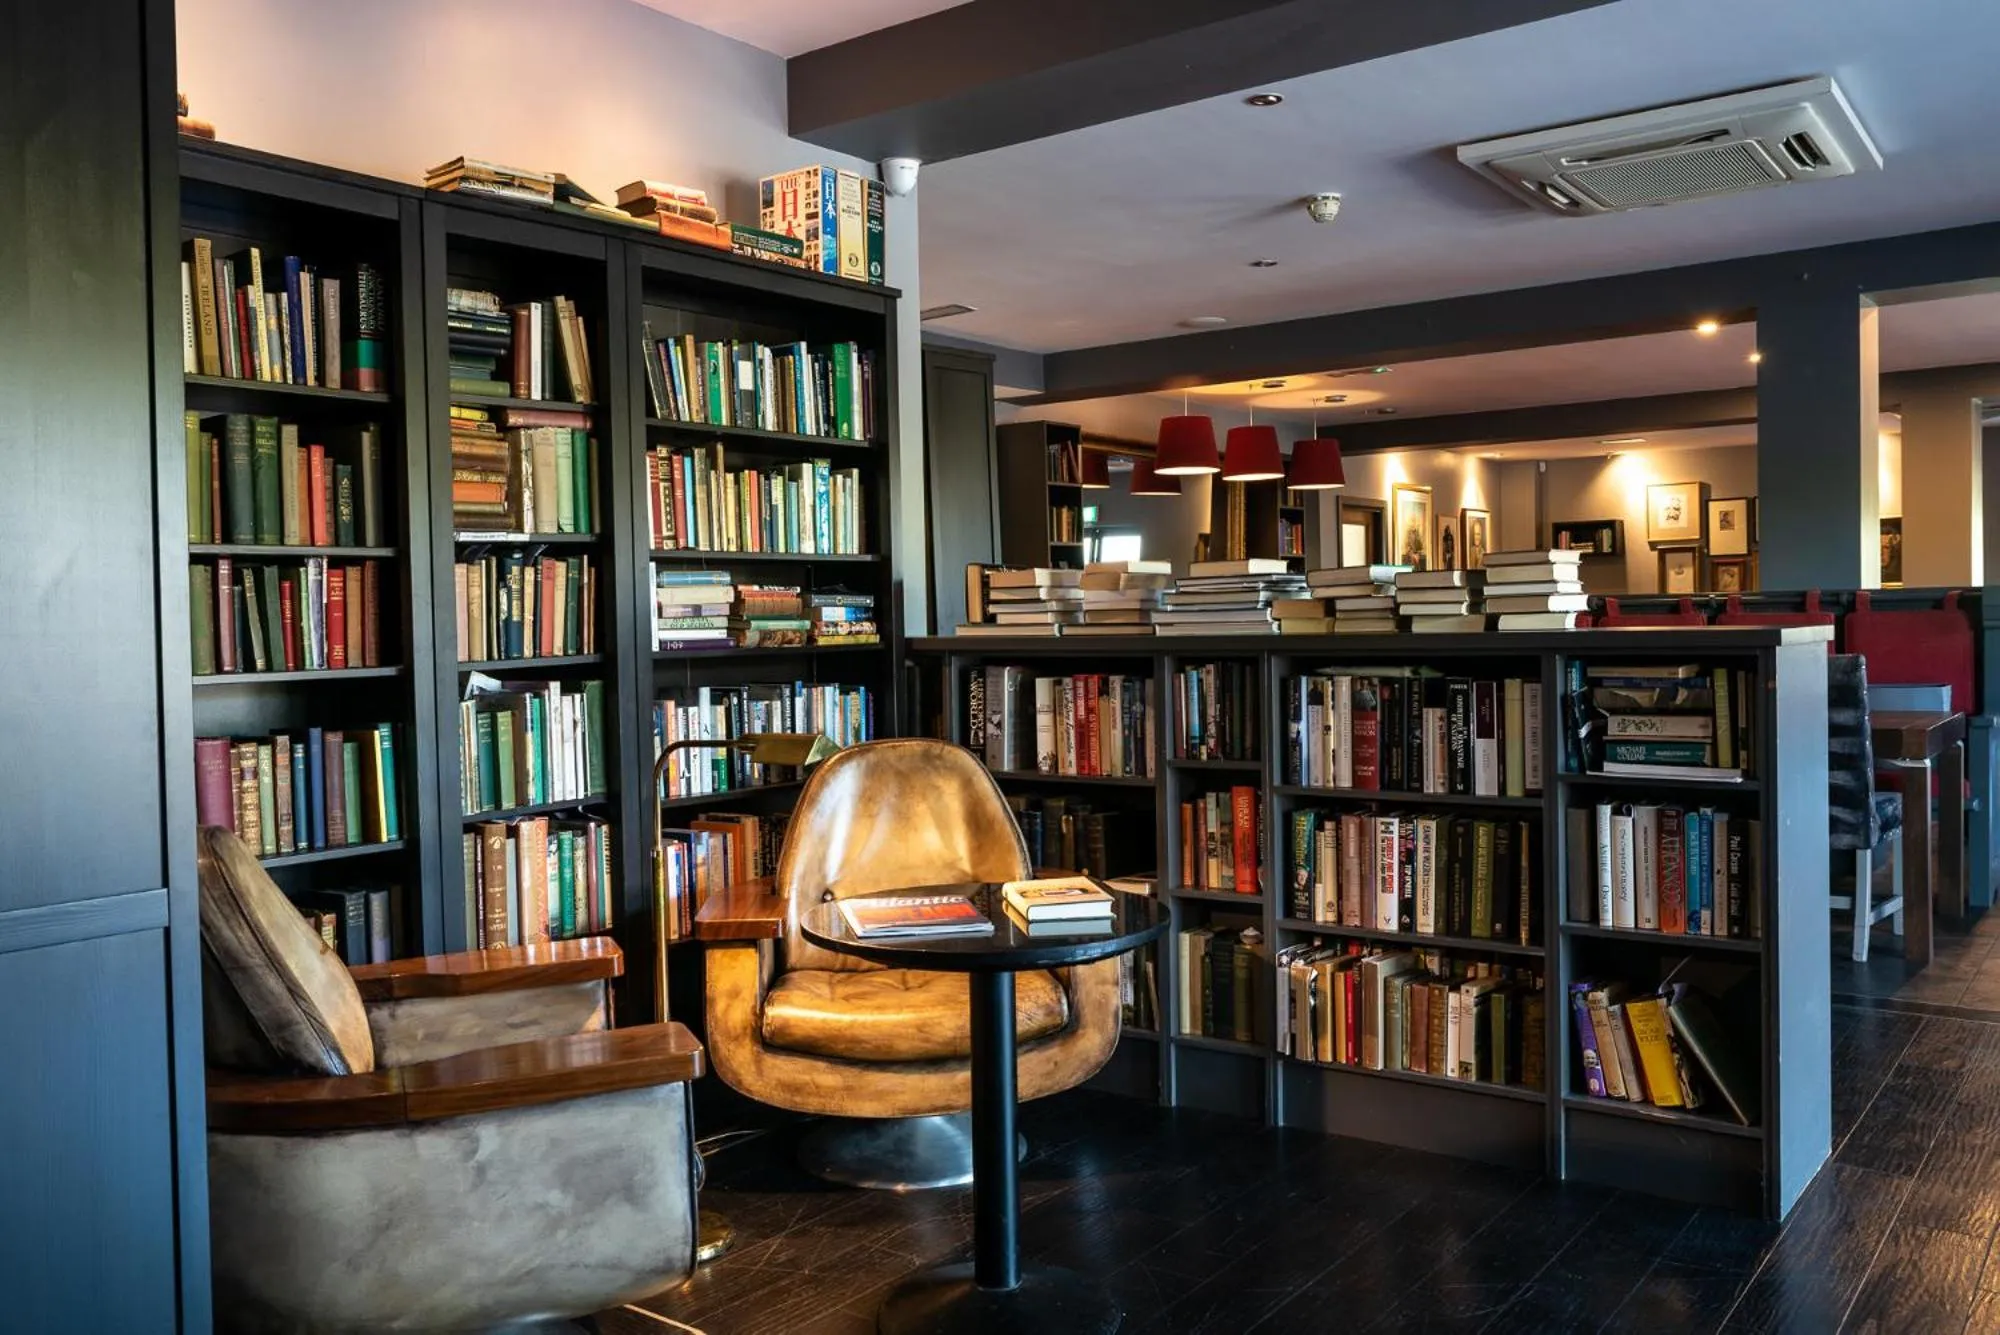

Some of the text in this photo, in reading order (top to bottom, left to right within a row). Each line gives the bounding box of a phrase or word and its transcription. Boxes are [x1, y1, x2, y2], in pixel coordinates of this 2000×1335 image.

[824, 182, 837, 220] 日本
[201, 284, 213, 336] IRELAND
[970, 681, 978, 729] WORLD
[1730, 835, 1741, 850] Paul
[1661, 833, 1681, 904] CONNOLLY
